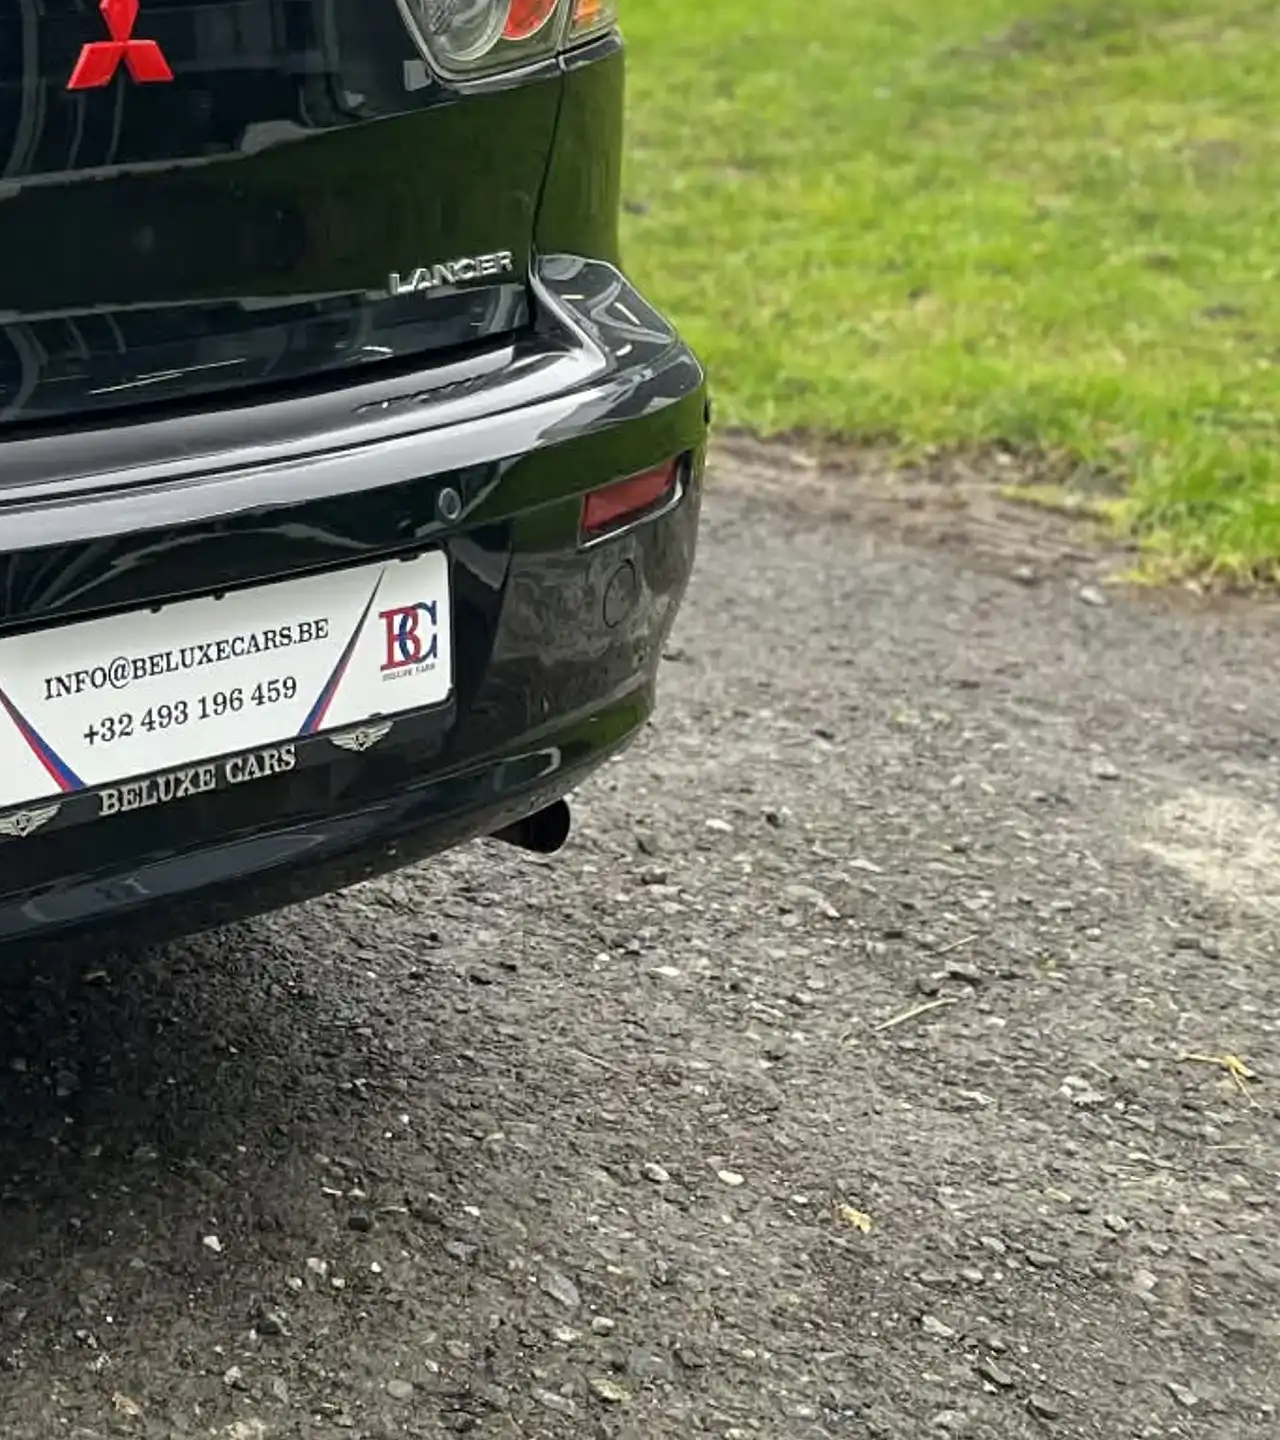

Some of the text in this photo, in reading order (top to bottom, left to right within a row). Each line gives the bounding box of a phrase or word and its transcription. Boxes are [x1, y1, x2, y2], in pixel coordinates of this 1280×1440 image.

[389, 251, 513, 295] LANCER
[44, 618, 330, 701] INFO@BELUXECARS.BE
[83, 676, 298, 746] +32 493 196 459
[97, 744, 297, 817] BELUXE CARS
